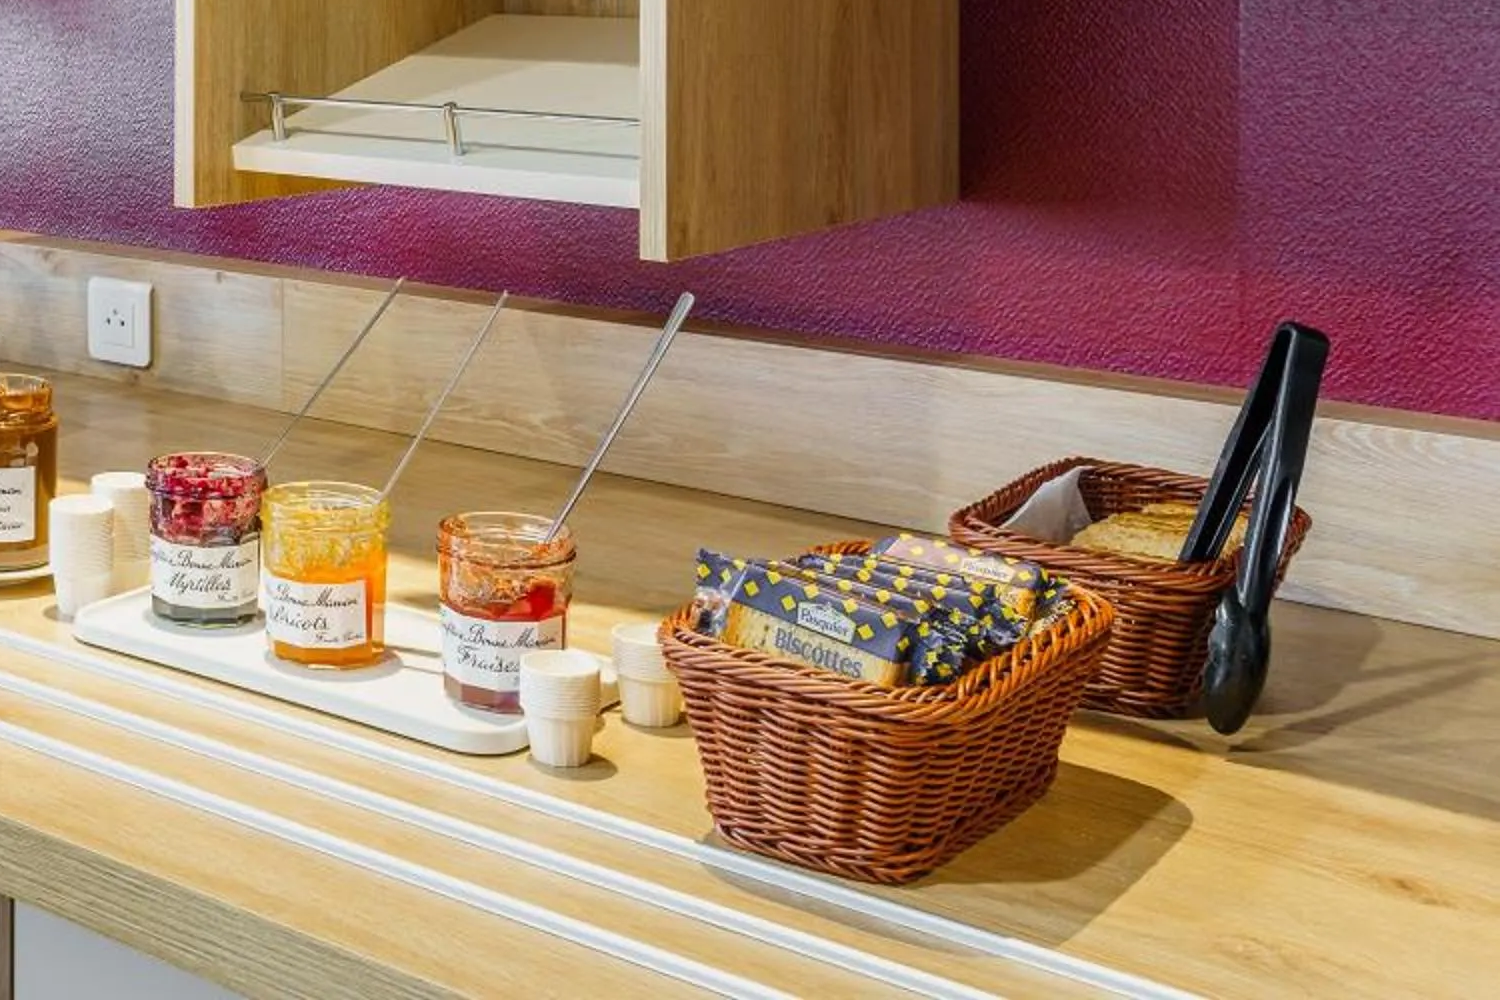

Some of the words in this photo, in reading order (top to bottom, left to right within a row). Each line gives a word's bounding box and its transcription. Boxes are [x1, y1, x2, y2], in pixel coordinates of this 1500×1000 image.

[169, 571, 232, 595] Myrtilles
[801, 607, 852, 638] Pasquier
[774, 626, 863, 679] Biscottes
